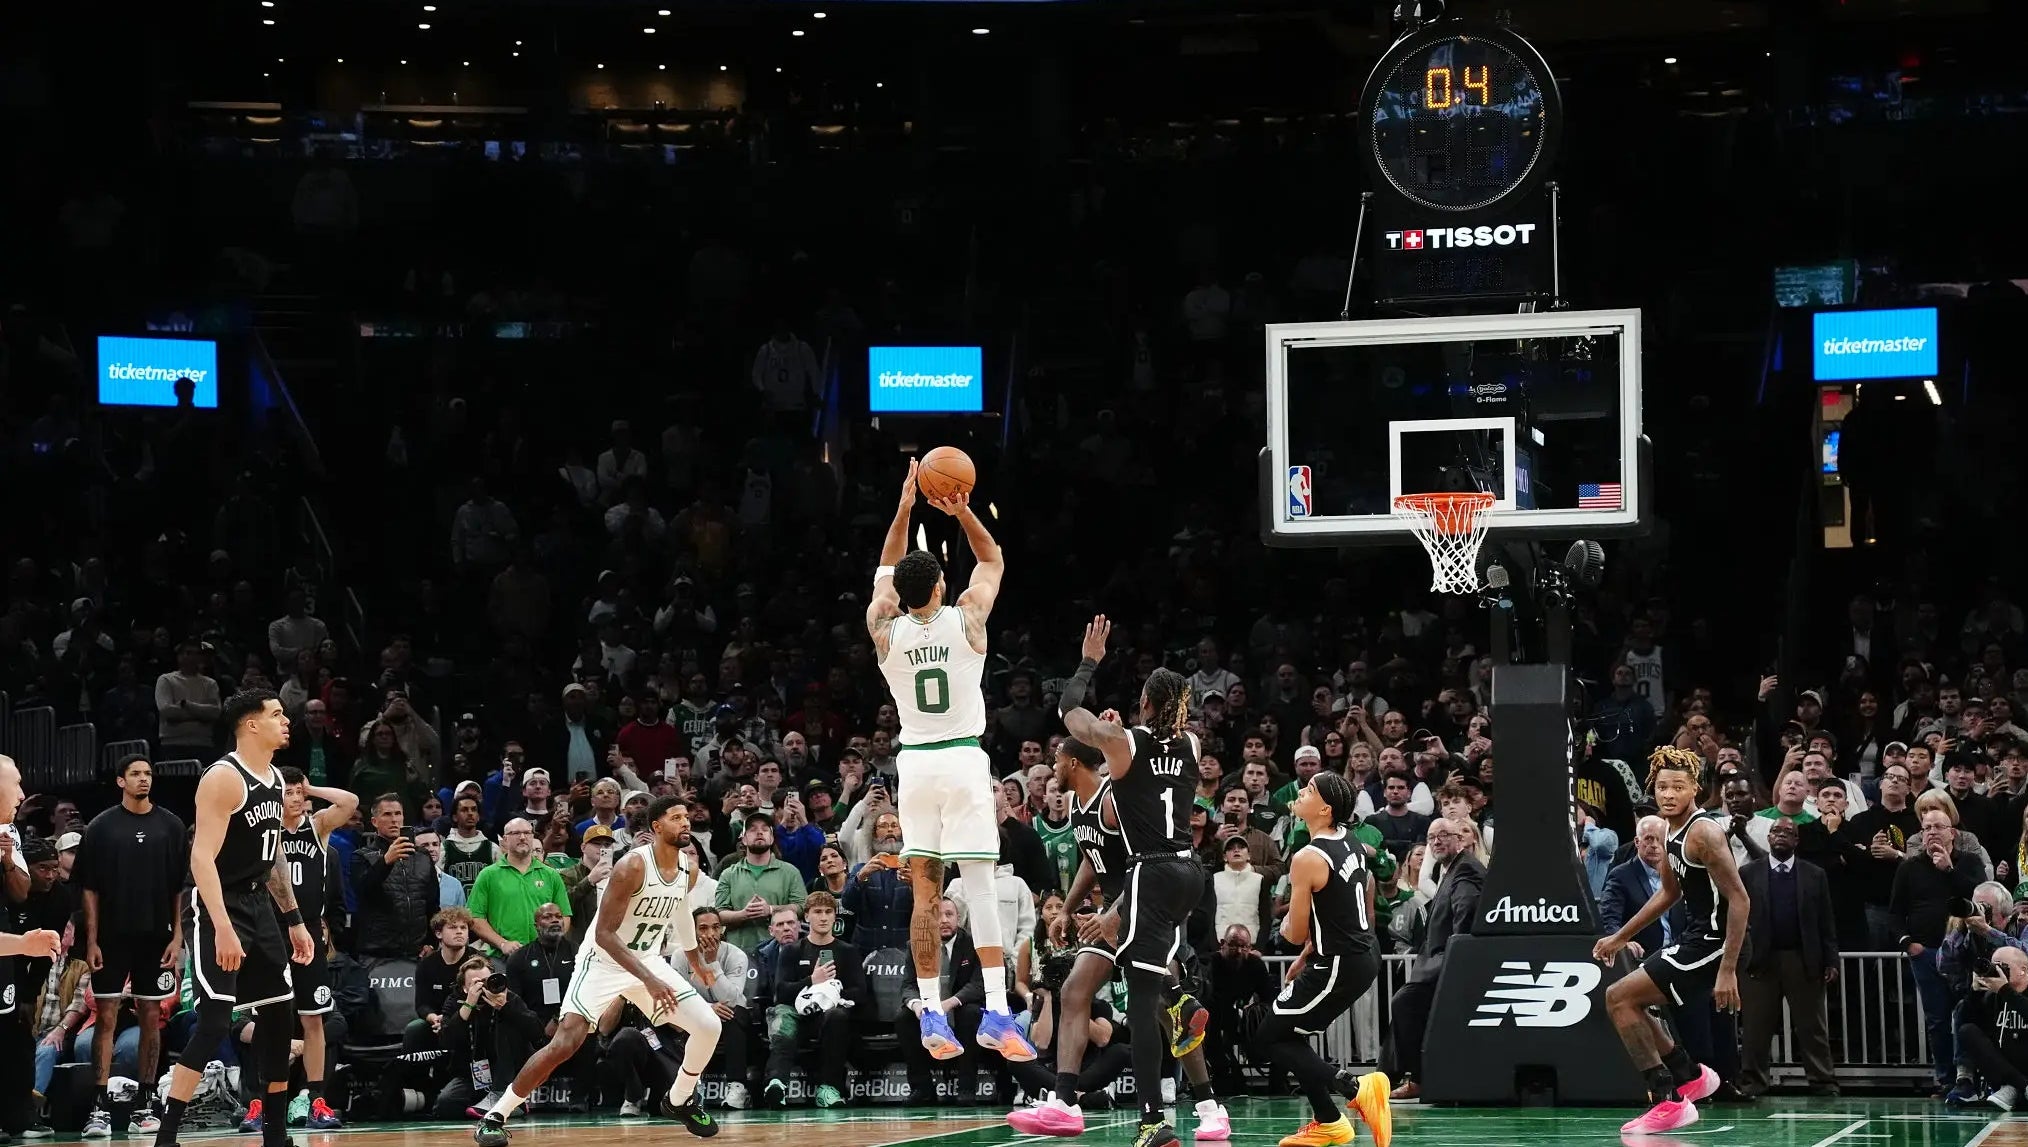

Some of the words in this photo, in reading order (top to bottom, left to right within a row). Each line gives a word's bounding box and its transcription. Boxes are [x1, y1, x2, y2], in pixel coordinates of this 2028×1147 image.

[1427, 66, 1488, 109] 0.4
[1426, 223, 1536, 249] TISSOT
[1823, 336, 1928, 355] ticketmaster
[108, 362, 208, 382] ticketmaster
[879, 370, 973, 388] ticketmaster
[904, 645, 950, 666] TATUM
[914, 667, 950, 714] 0
[1149, 756, 1184, 776] ELLIS
[1160, 787, 1175, 839] 1
[261, 829, 279, 861] 17
[1355, 881, 1369, 931] 0
[1485, 895, 1580, 923] Amica
[626, 922, 664, 952] 13
[369, 976, 415, 989] PIMC
[1467, 961, 1602, 1027] NB
[525, 1083, 572, 1104] tBlu
[785, 1080, 817, 1099] Blu
[847, 1078, 911, 1100] jetBlue
